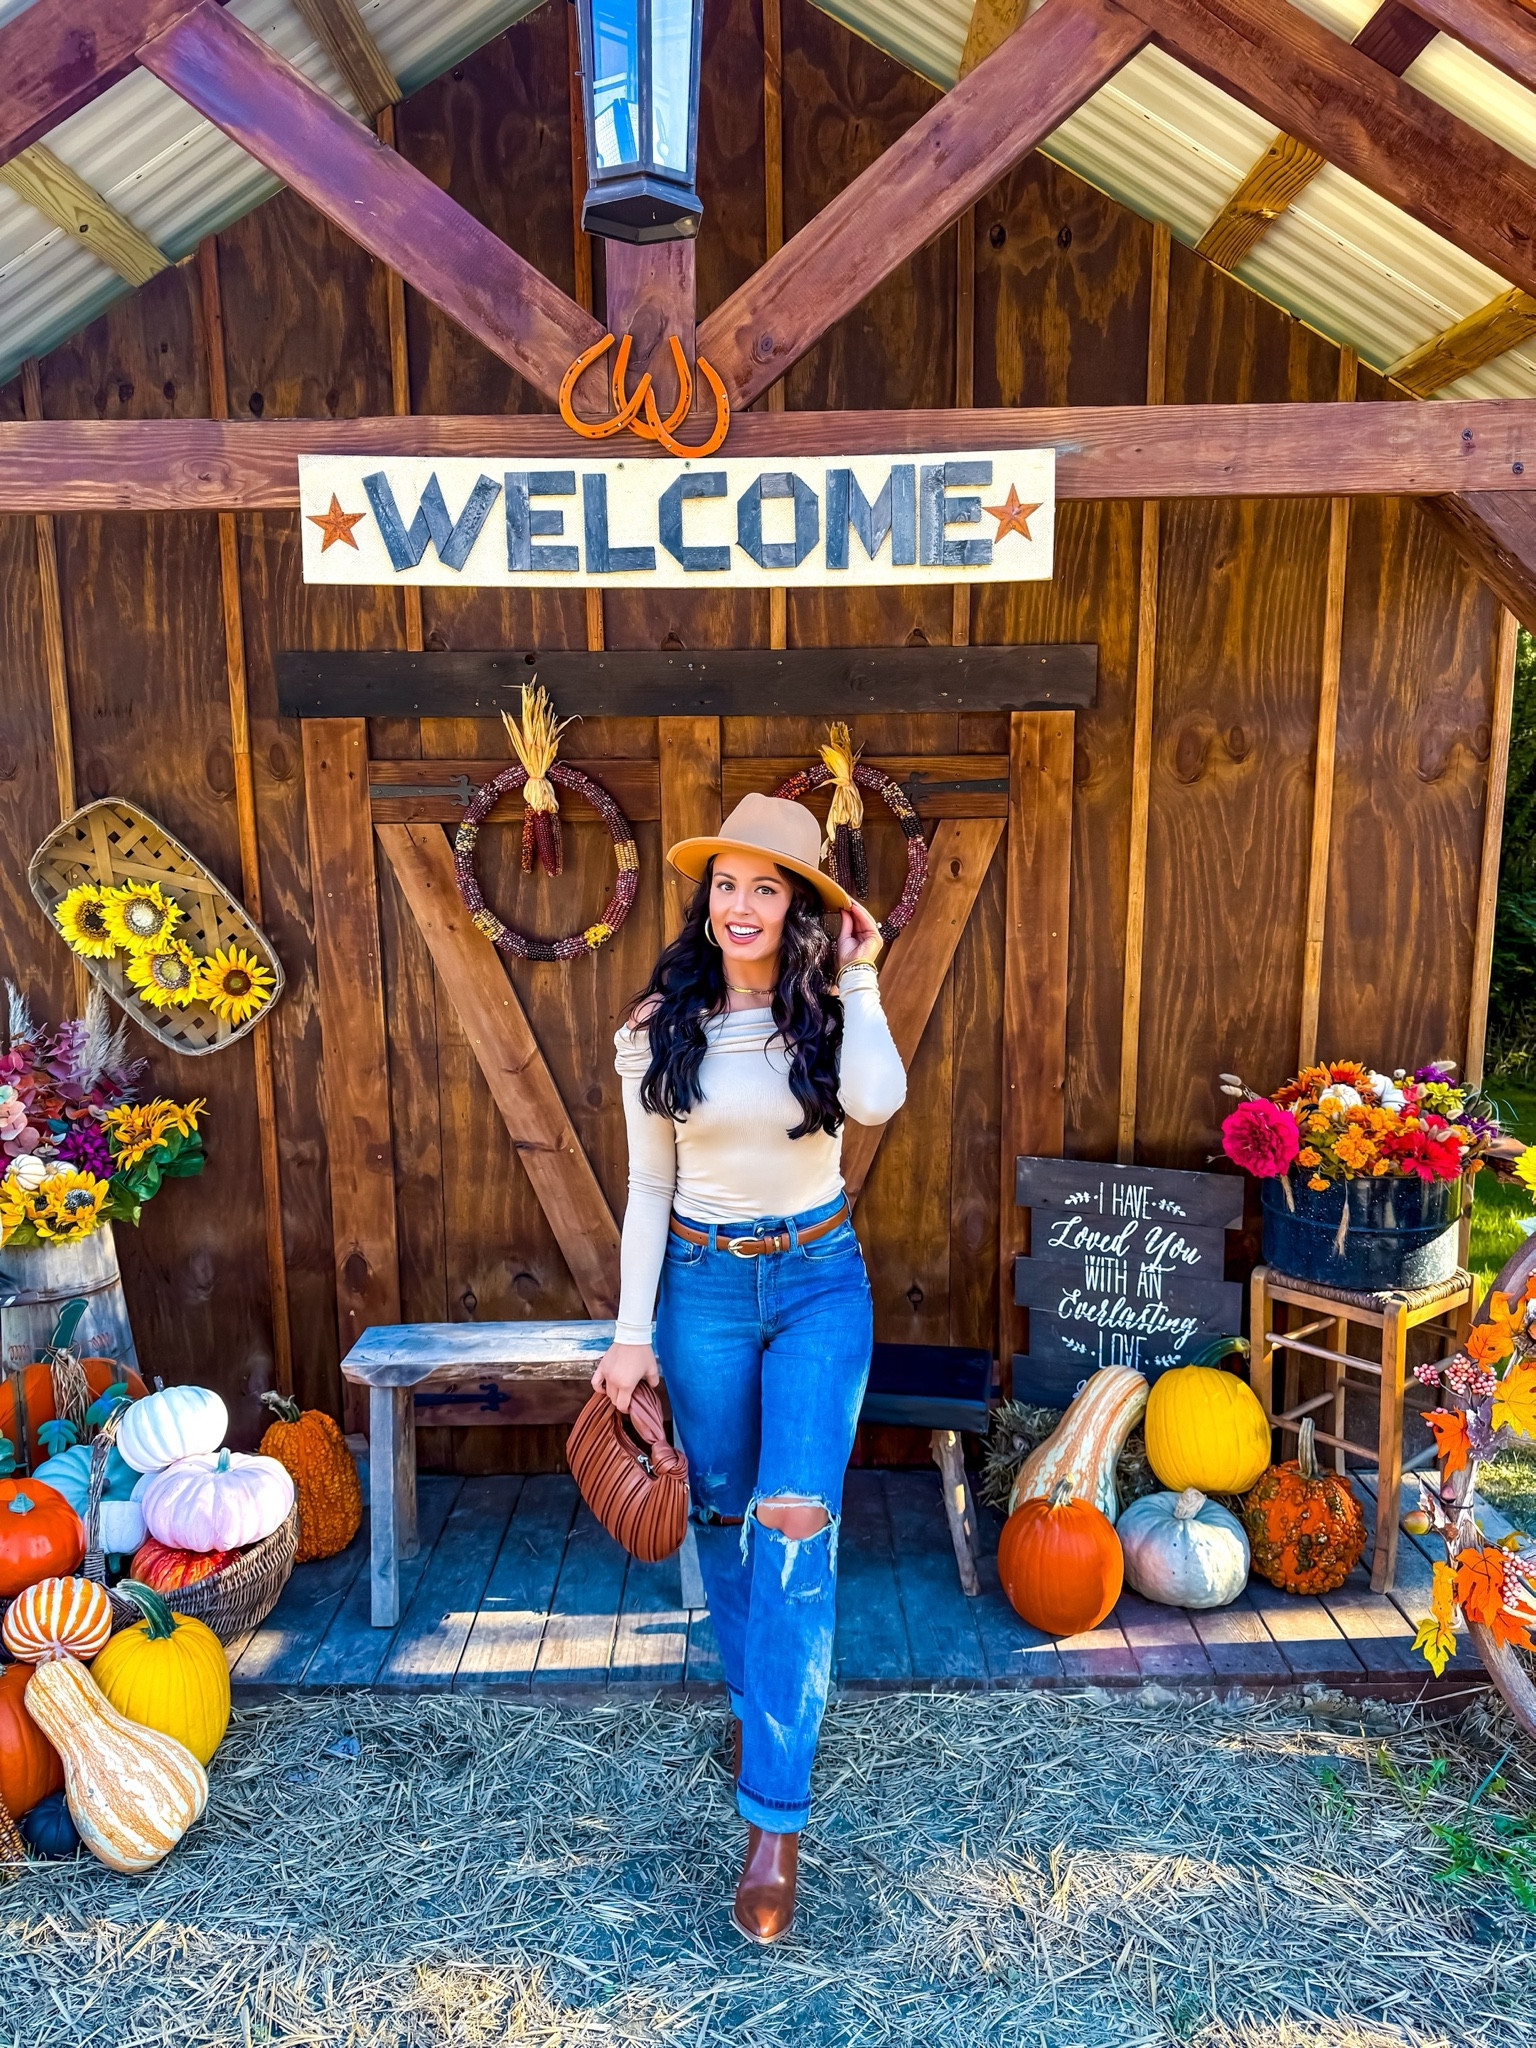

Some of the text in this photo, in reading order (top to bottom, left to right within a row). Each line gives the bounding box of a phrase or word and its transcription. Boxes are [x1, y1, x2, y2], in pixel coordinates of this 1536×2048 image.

[362, 461, 993, 573] WELCOME
[1099, 1181, 1154, 1220] I HAVE
[1048, 1216, 1202, 1272] Loved You
[1084, 1255, 1163, 1299] WITH AN
[1057, 1288, 1199, 1350] Everlasting
[1098, 1331, 1147, 1374] LOVE
